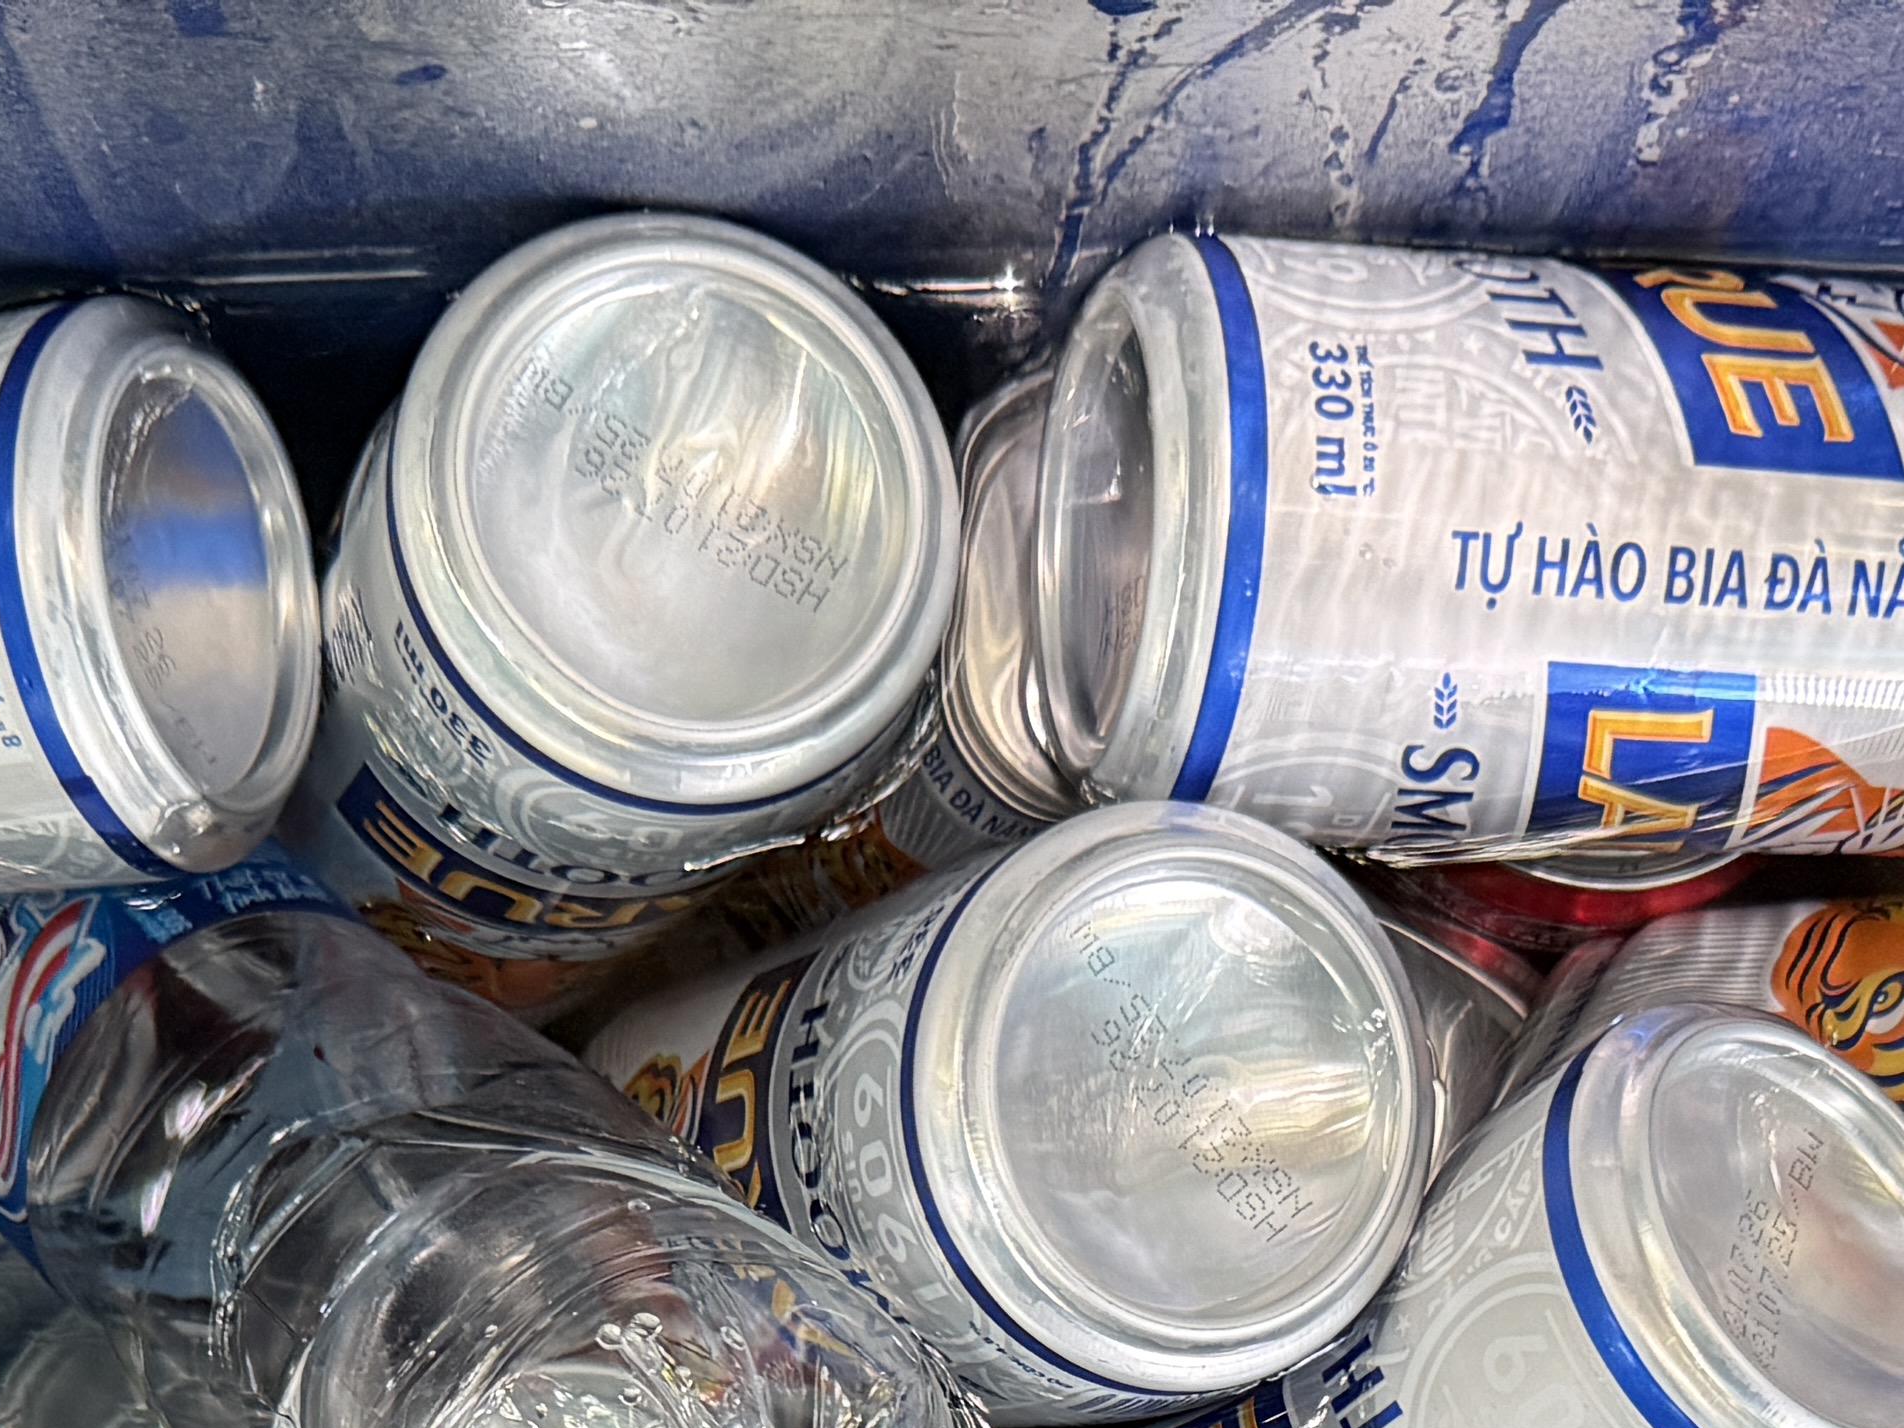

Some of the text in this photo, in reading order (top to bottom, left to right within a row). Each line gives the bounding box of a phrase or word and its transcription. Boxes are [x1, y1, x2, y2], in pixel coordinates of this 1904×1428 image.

[1309, 340, 1357, 498] 330 ml
[1452, 519, 1524, 610] TỰ
[1532, 522, 1647, 603] HÀO
[1663, 553, 1749, 611] BIA
[1765, 538, 1831, 613] ĐÀ
[4, 733, 23, 748] 8
[945, 780, 991, 826] ĐÀ
[1086, 1013, 1289, 1247] HSD:21.07.26
